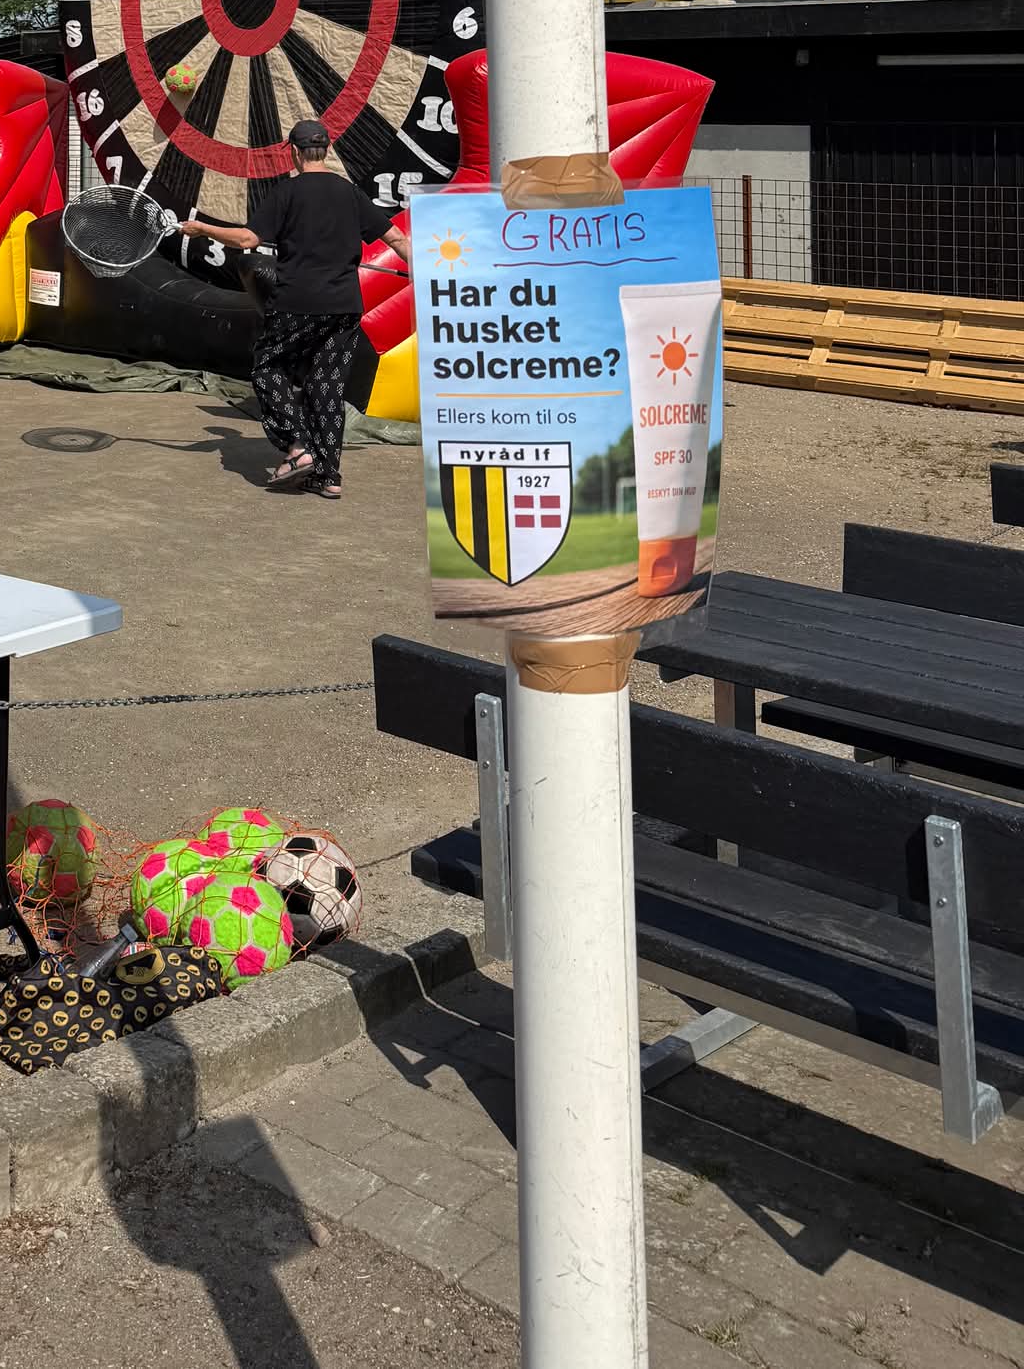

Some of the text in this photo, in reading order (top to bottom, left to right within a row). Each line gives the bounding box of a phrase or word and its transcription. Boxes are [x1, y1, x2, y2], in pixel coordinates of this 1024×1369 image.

[65, 19, 83, 48] 8
[453, 6, 478, 40] 6
[76, 88, 105, 122] 16
[105, 155, 123, 185] 7
[501, 211, 646, 252] GRATIS
[204, 236, 226, 266] 3
[430, 278, 557, 307] Har du
[432, 315, 561, 344] husket
[433, 348, 621, 380] solcreme?
[437, 408, 576, 424] Ellers kom til os
[639, 403, 707, 428] SOLCREME
[460, 447, 525, 462] nyråd
[654, 449, 693, 465] SPF 30
[517, 476, 550, 488] 1927
